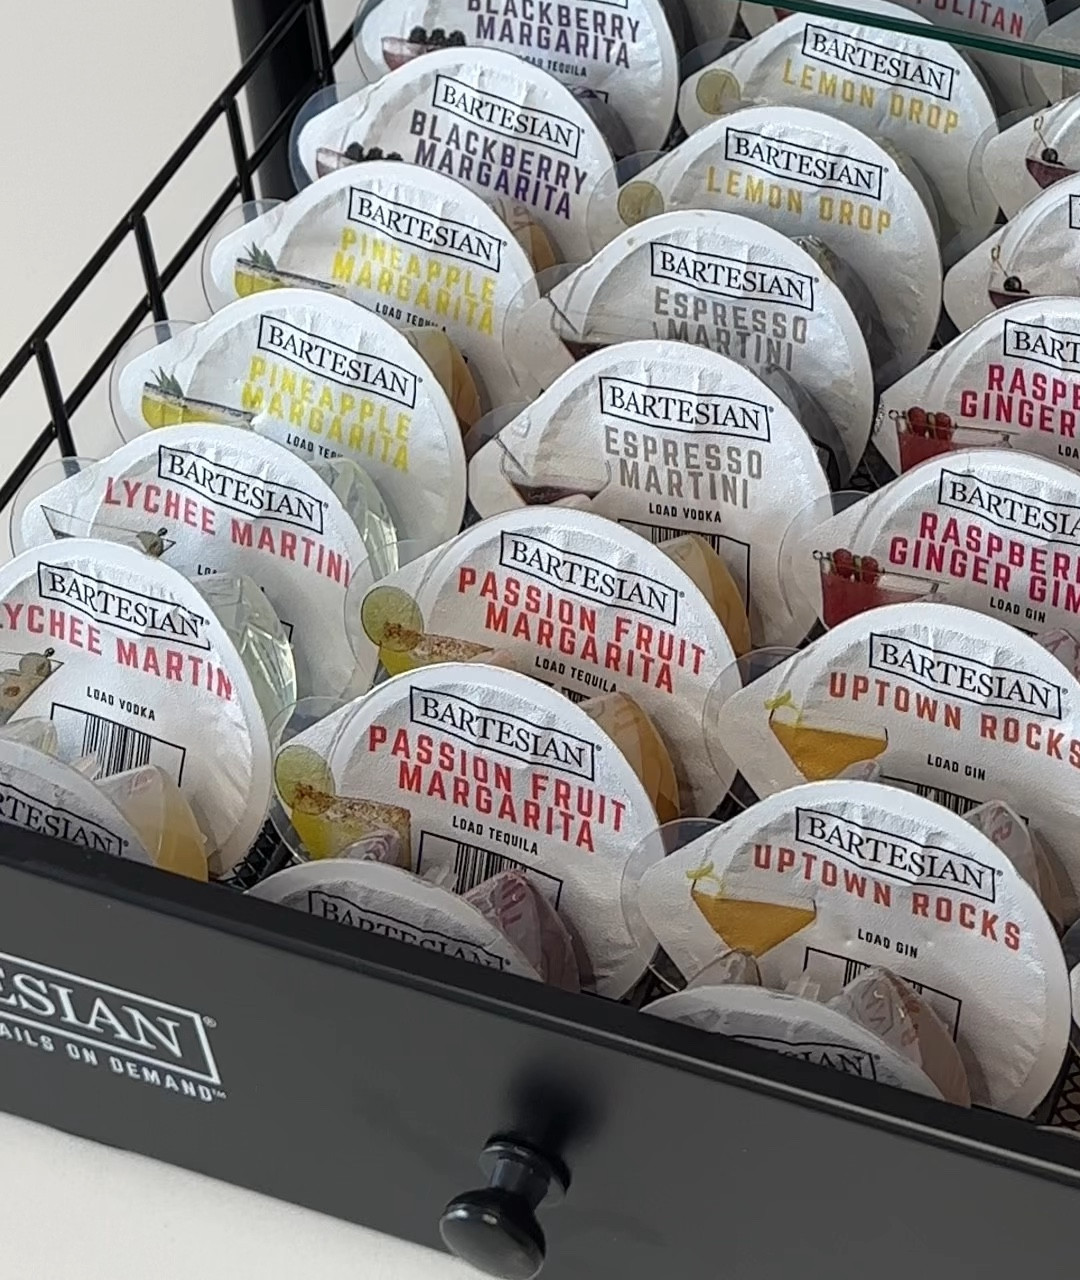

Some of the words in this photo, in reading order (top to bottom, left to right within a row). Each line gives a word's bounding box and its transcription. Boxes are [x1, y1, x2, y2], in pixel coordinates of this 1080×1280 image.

[476, 14, 631, 69] MARGARITA
[548, 59, 588, 77] TEQUILA
[812, 31, 945, 91] BARTESIAN
[443, 83, 575, 148] BARTESIAN
[783, 58, 874, 109] LEMON
[890, 92, 960, 135] DROP
[410, 109, 590, 196] BLACKBERRY
[414, 139, 572, 221] MARGARITA
[735, 137, 876, 190] BARTESIAN
[358, 195, 494, 263] BARTESIAN
[706, 166, 803, 215] LEMON
[819, 196, 892, 235] DROP
[331, 250, 496, 337] MARGARITA
[340, 226, 497, 301] PINEAPPLE
[660, 250, 805, 301] BARTESIAN
[375, 302, 402, 321] LOAD
[655, 286, 808, 344] ESPRESSO
[269, 324, 410, 398] BARTESIAN
[664, 318, 794, 372] MARTINI
[249, 355, 412, 438] PINEAPPLE
[610, 385, 760, 432] BARTESIAN
[960, 390, 1077, 439] GINGER
[241, 386, 409, 473] MARGARITA
[286, 433, 314, 452] LOAD
[604, 426, 764, 481] ESPRESSO
[169, 455, 316, 523] BARTESIAN
[620, 462, 749, 510] MARTINI
[649, 502, 679, 519] LOAD
[683, 507, 722, 524] VODKA
[105, 477, 216, 536] LYCHEE
[231, 518, 351, 588] MARTINI
[511, 539, 668, 613] BARTESIAN
[889, 536, 1012, 593] GINGER
[0, 602, 102, 656] YCHEE
[50, 571, 200, 639] BARTESIAN
[458, 567, 598, 635] PASSION
[615, 615, 706, 675] FRUIT
[990, 596, 1020, 617] LOAD
[1025, 606, 1046, 624] GIN
[485, 602, 674, 694] MARGARITA
[535, 655, 566, 675] LOAD
[570, 666, 617, 693] TEQUILA
[880, 643, 1052, 709] BARTESIAN
[87, 686, 114, 707] LOAD
[118, 699, 156, 722] VODKA
[829, 671, 961, 731] UPTOWN
[420, 696, 586, 768] BARTESIAN
[368, 725, 513, 793] PASSION
[531, 773, 627, 833] FRUIT
[927, 753, 959, 773] LOAD
[964, 764, 986, 781] GIN
[399, 760, 595, 853] MARGARITA
[452, 815, 484, 835] LOAD
[488, 827, 539, 856] TEQUILA
[807, 816, 985, 891] BARTESIAN
[753, 844, 893, 908] UPTOWN
[911, 891, 1022, 952] ROCKS
[857, 928, 890, 950] LOAD
[896, 940, 918, 960] GIN
[66, 1042, 99, 1066] ON
